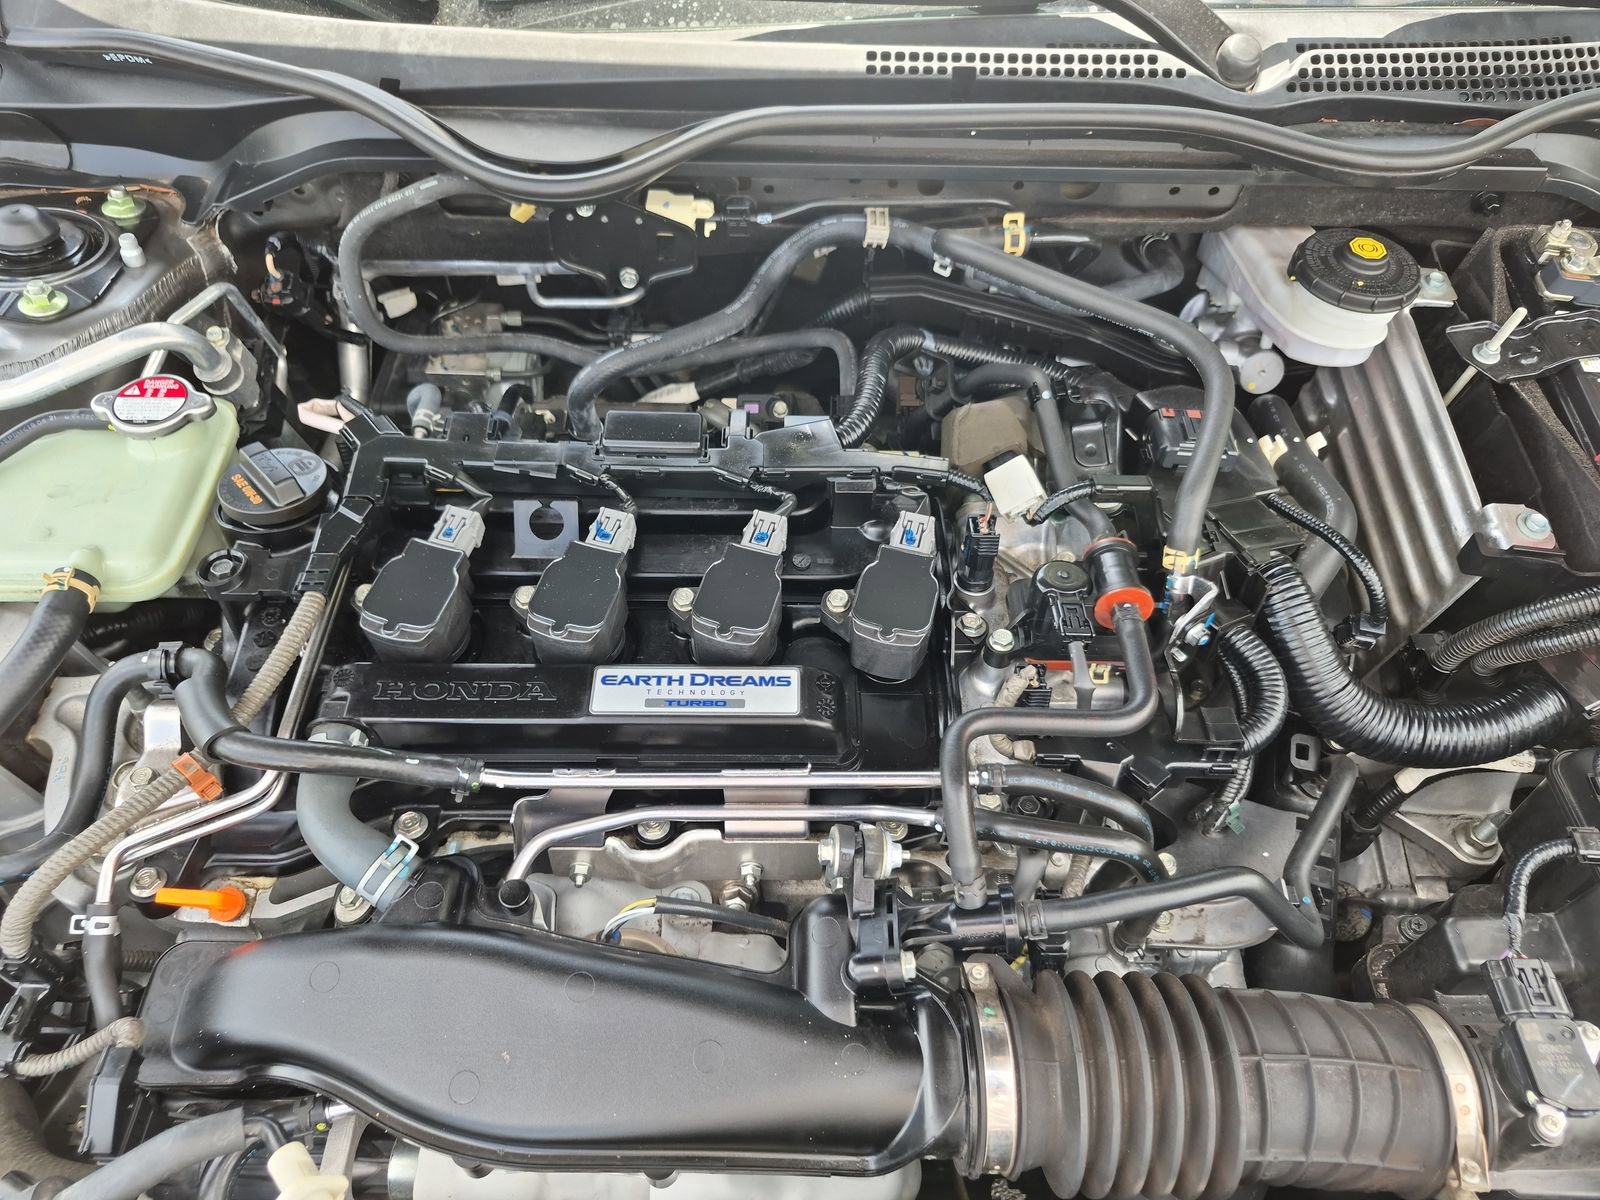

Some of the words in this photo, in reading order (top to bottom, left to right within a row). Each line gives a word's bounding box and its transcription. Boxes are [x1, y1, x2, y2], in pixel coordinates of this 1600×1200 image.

[600, 674, 684, 687] EARTH
[689, 673, 792, 687] DREAMS
[373, 680, 558, 701] HONDA
[646, 688, 746, 696] TECHNOLOGY
[665, 699, 727, 708] TURBO
